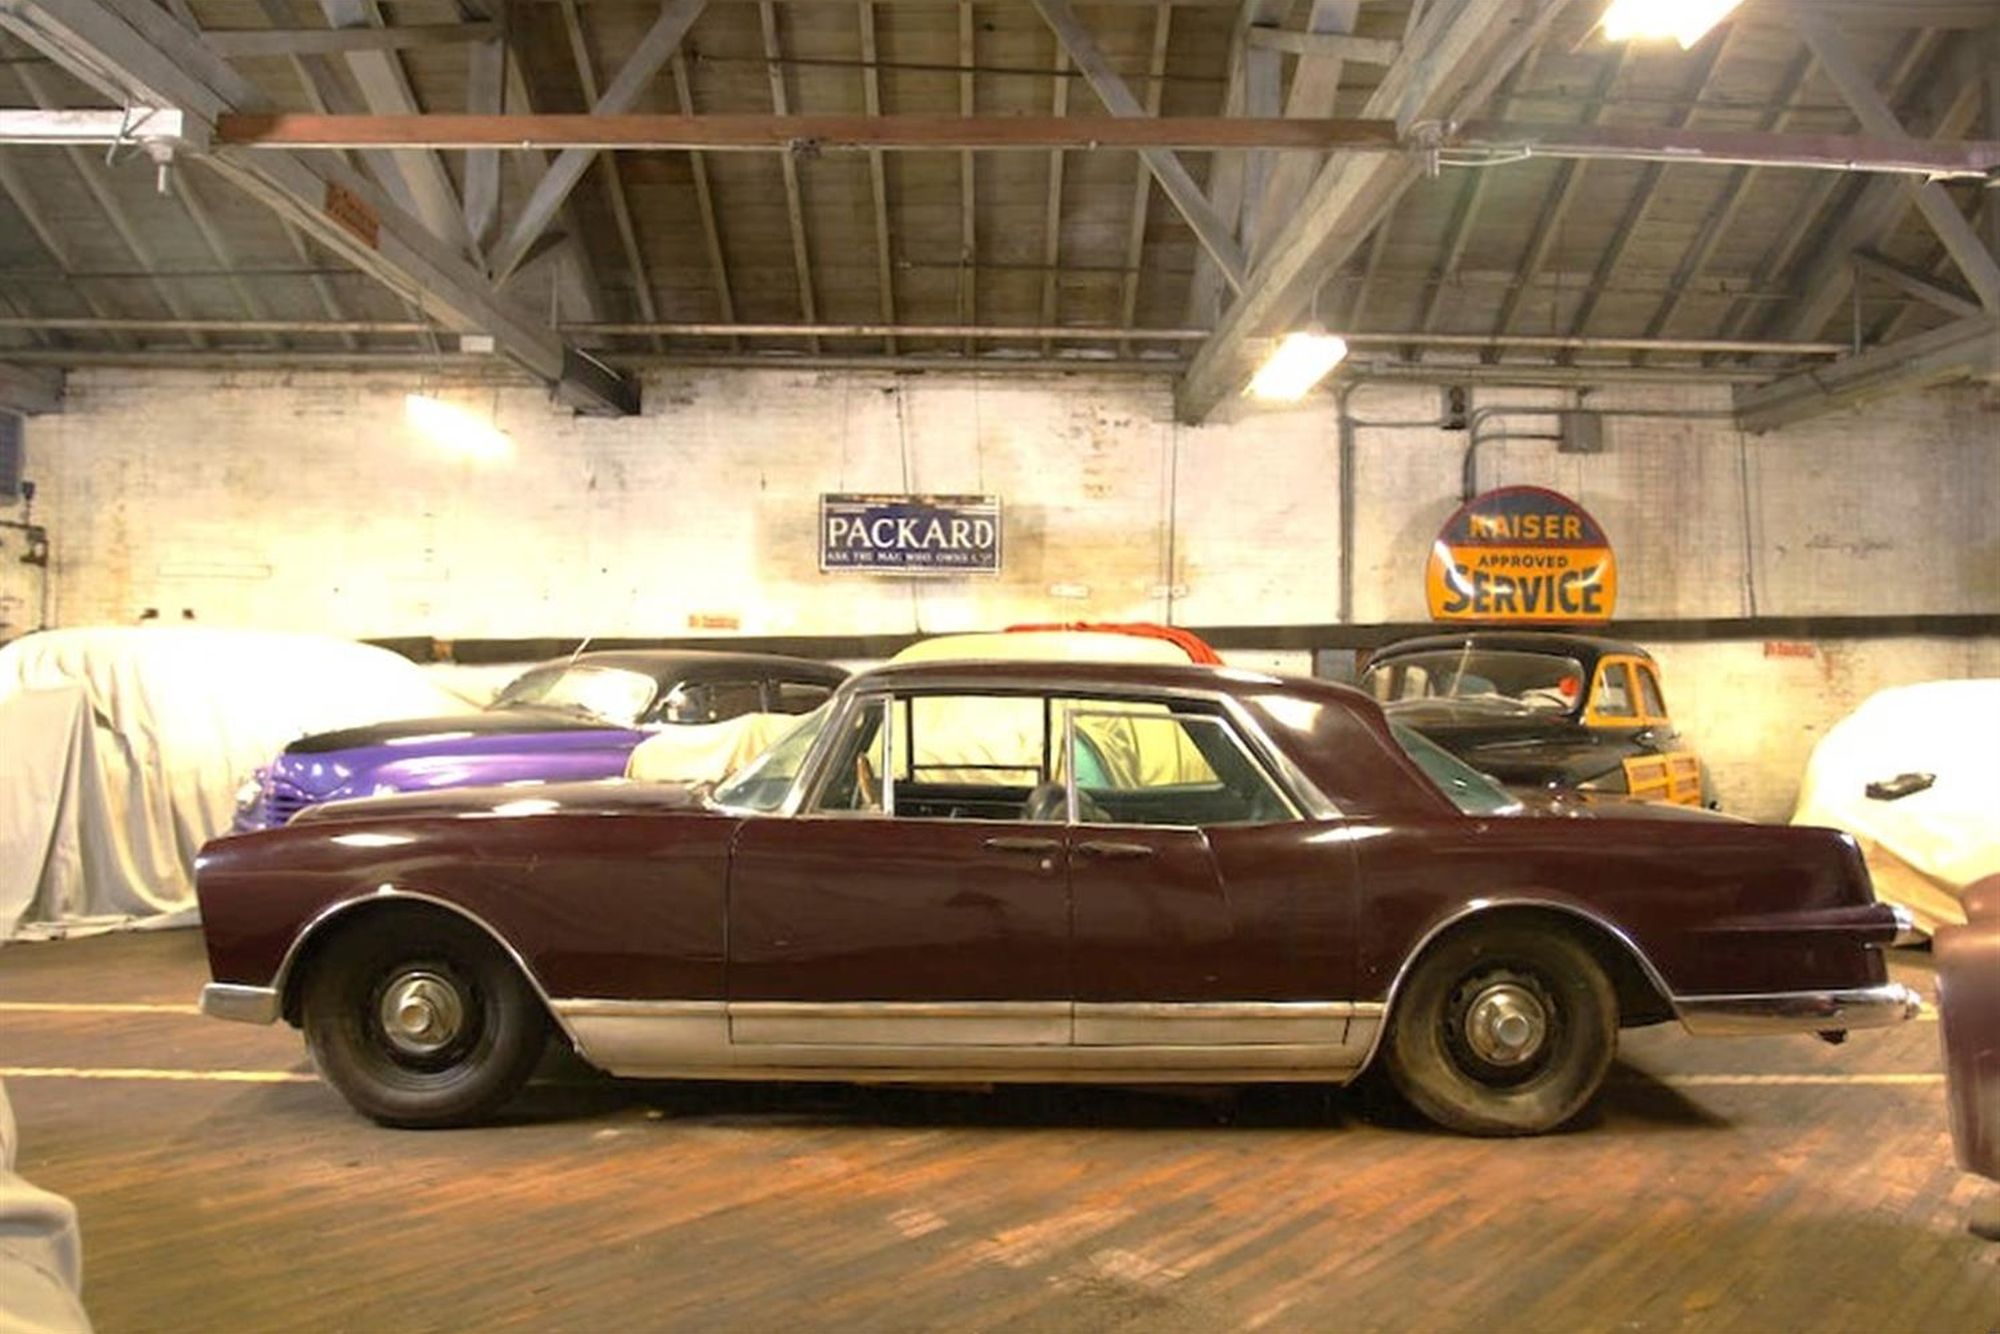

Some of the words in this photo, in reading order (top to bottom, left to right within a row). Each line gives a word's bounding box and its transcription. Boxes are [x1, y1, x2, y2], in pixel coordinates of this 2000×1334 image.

[828, 517, 994, 549] PACKARD
[1469, 514, 1583, 540] KAISER
[1478, 555, 1568, 568] APPROVED
[1443, 564, 1604, 614] SERVICE
